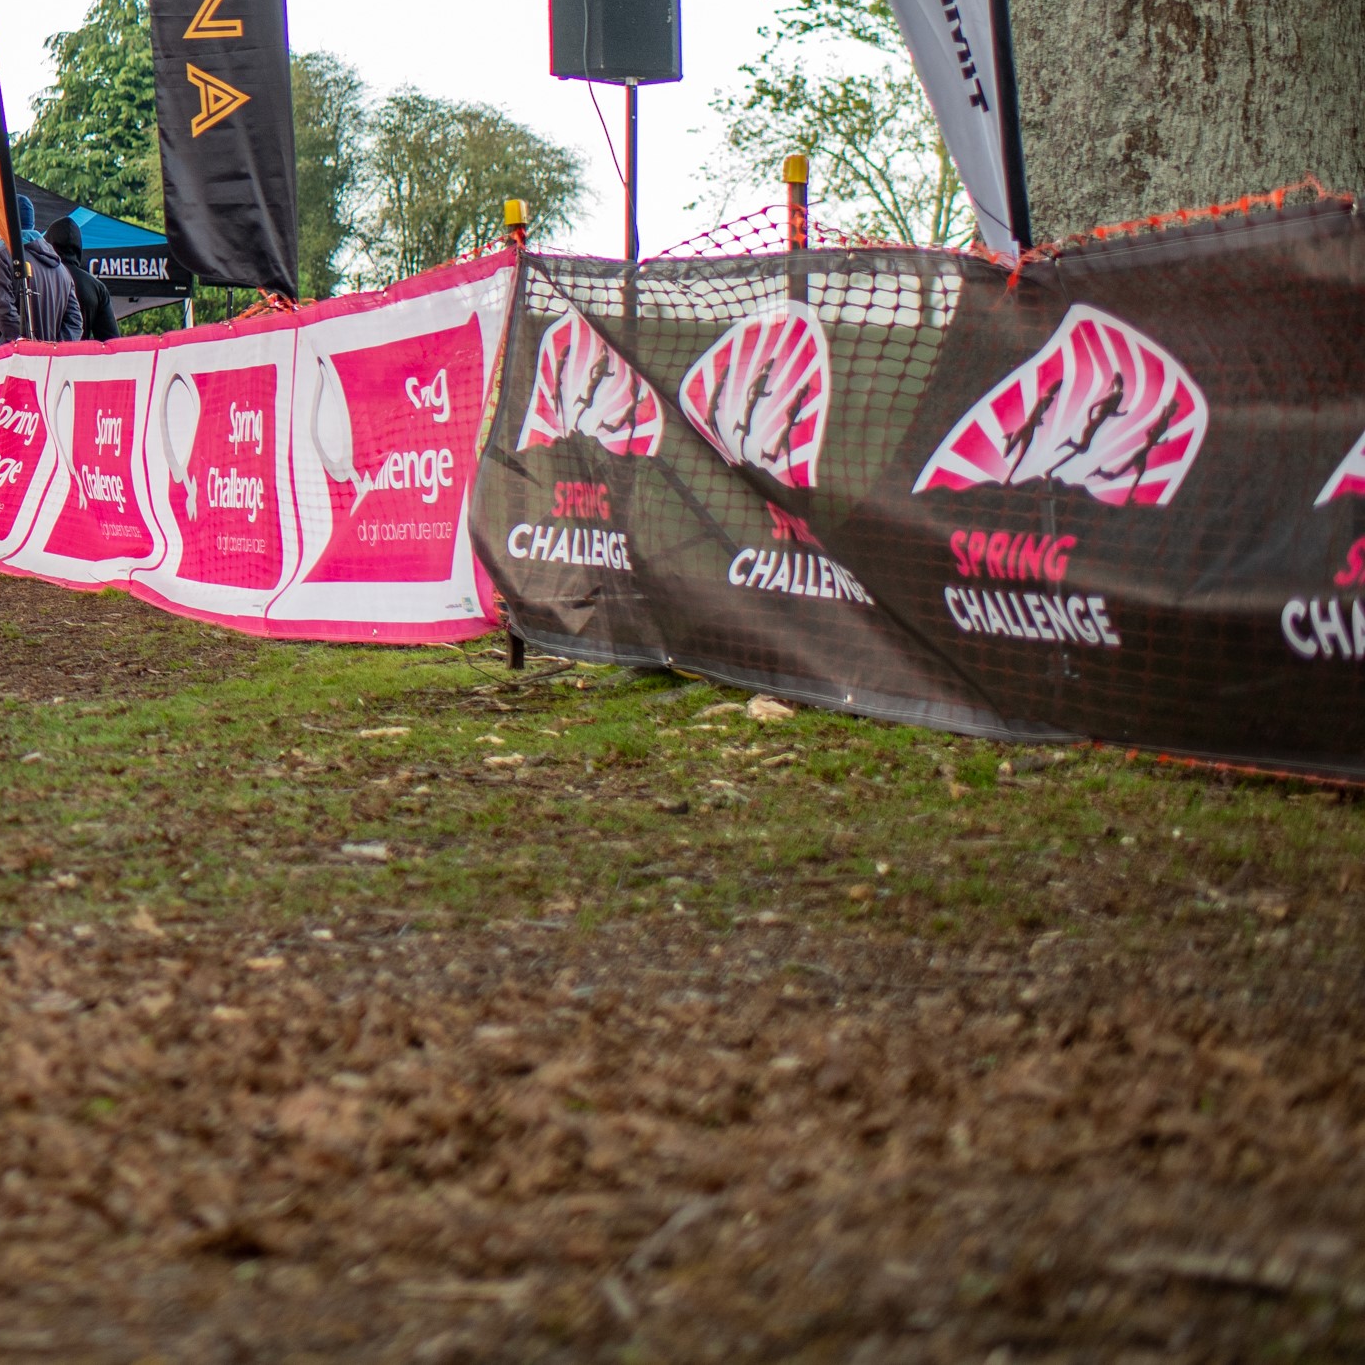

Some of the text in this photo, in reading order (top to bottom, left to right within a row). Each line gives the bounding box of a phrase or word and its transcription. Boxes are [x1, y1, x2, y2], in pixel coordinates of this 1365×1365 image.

[89, 257, 170, 280] CAMELBAK
[95, 408, 122, 457] Spring
[229, 400, 263, 456] Spring
[81, 464, 127, 514] Challenge
[207, 466, 265, 523] Challenge
[551, 481, 611, 521] SPRING
[950, 529, 1077, 582] SPRING
[944, 586, 1122, 647] CHALLENGE
